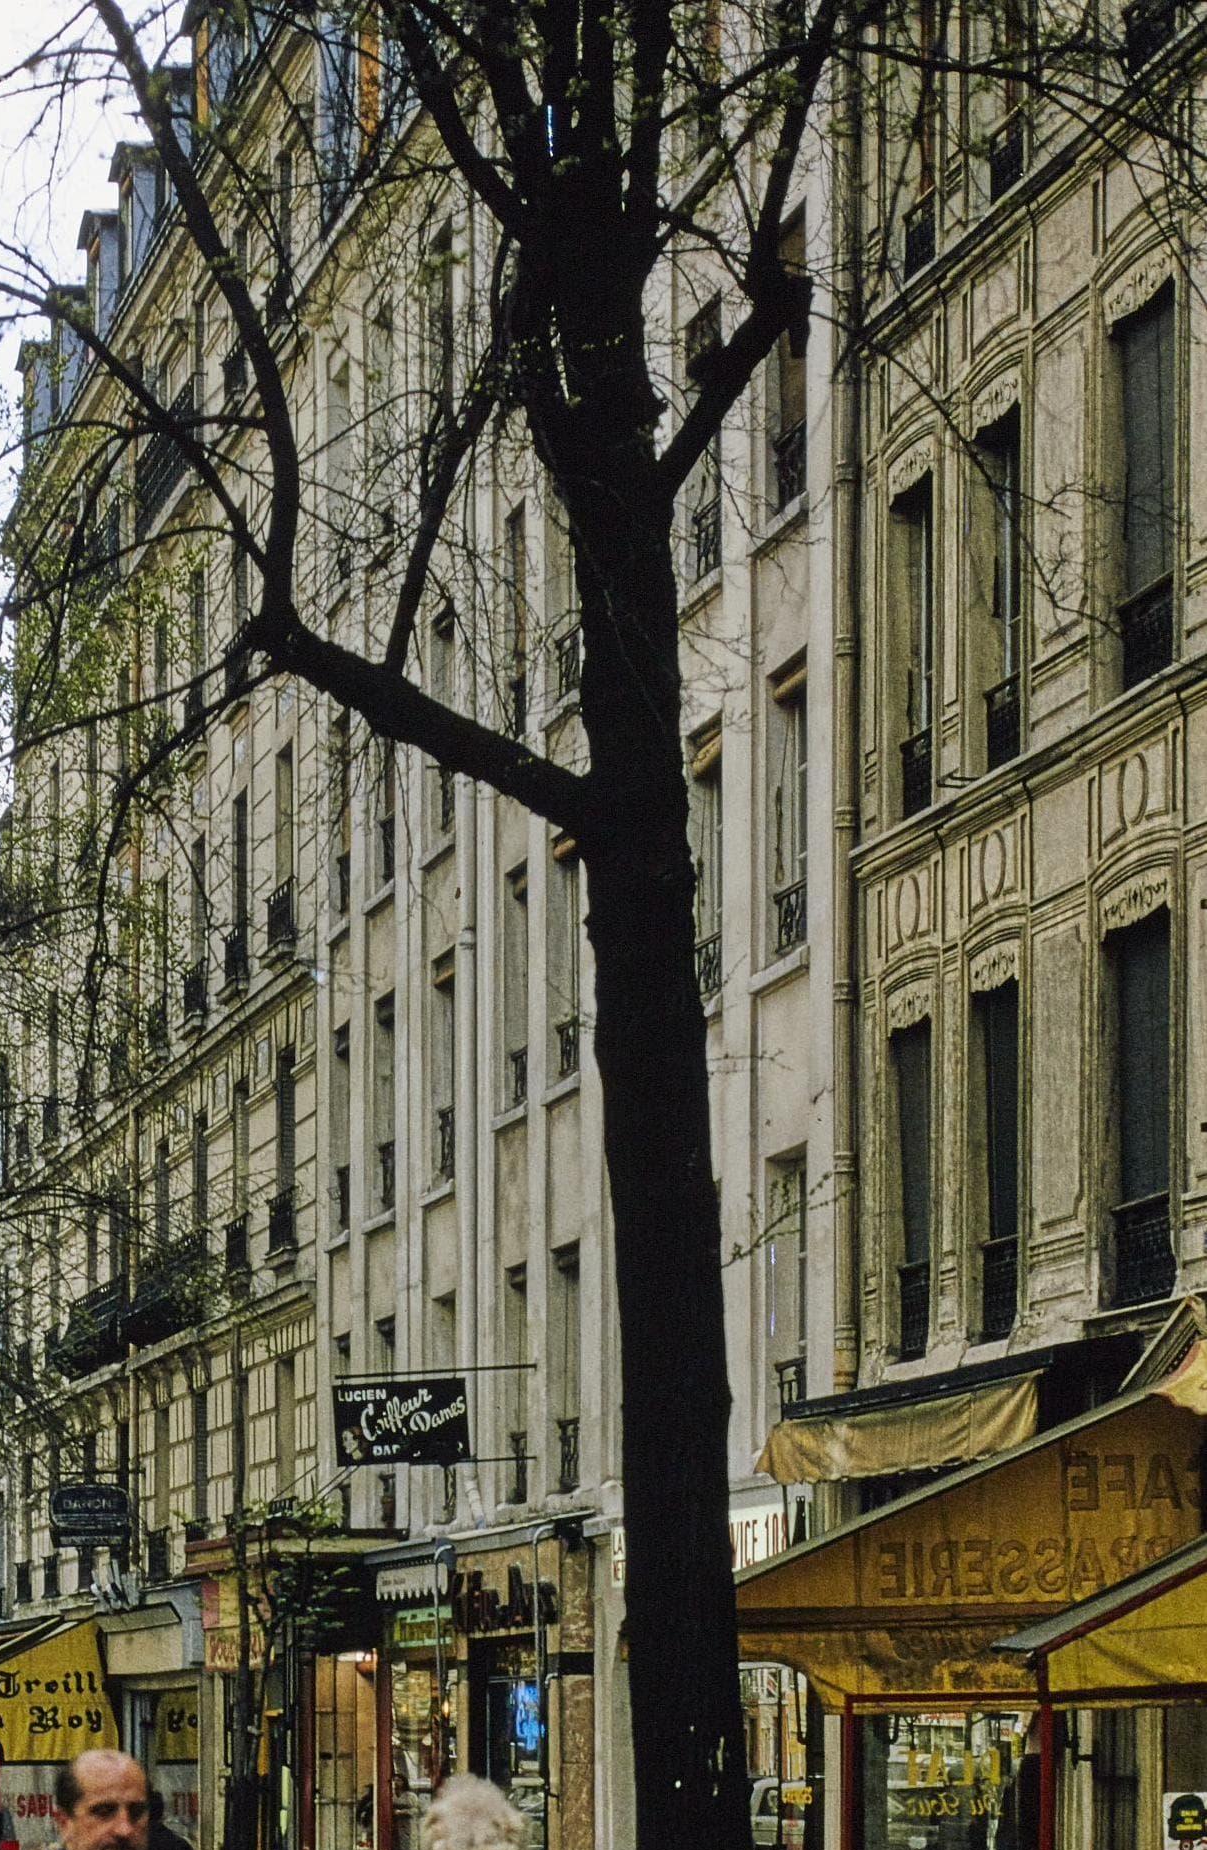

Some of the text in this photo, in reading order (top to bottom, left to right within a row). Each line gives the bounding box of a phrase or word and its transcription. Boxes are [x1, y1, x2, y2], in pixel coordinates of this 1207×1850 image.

[338, 1388, 387, 1402] LUCIEN
[360, 1388, 432, 1441] Coiffeur
[409, 1395, 466, 1433] Dames
[28, 1705, 102, 1734] Roy
